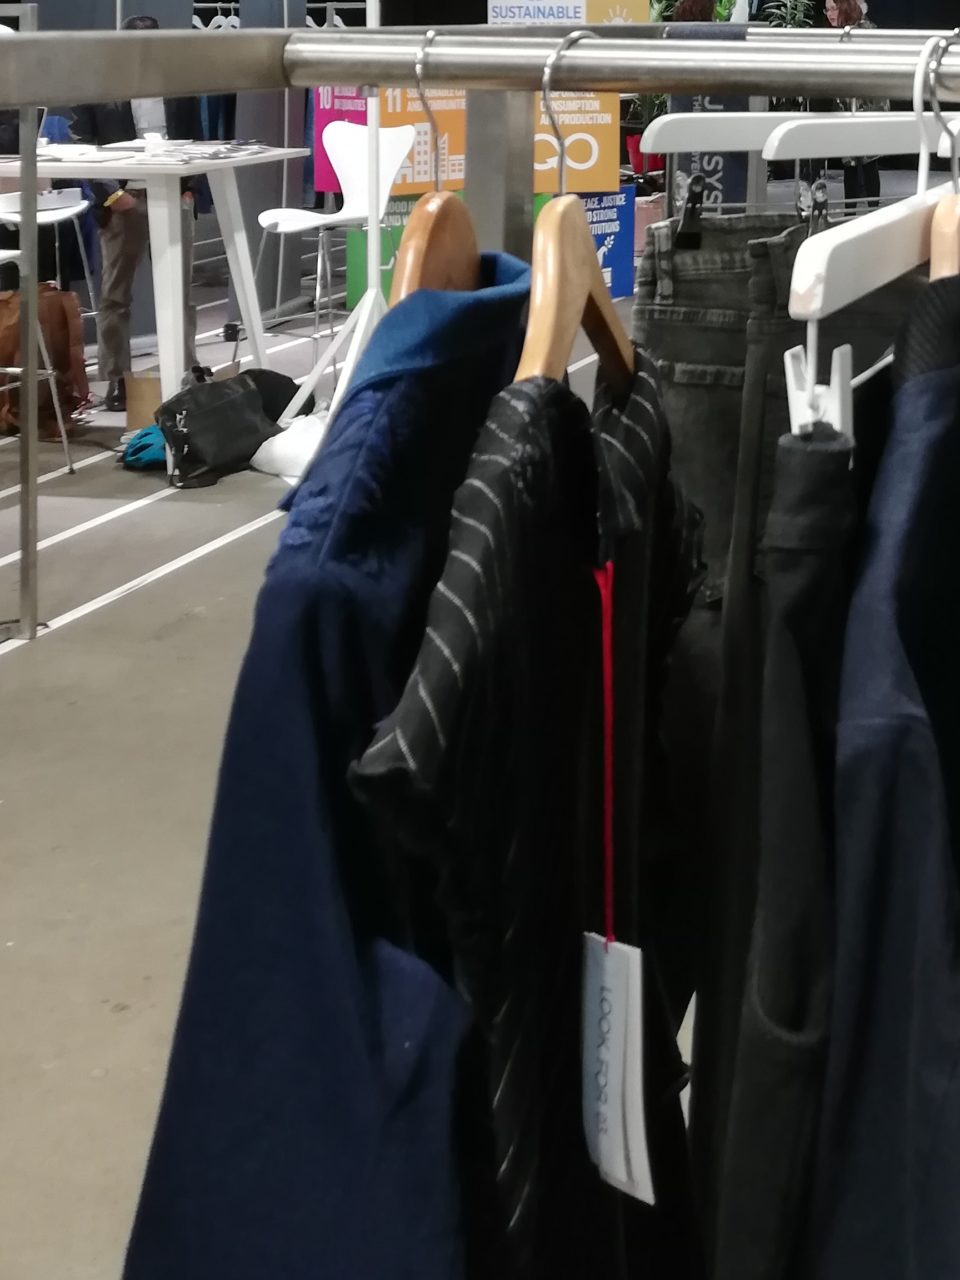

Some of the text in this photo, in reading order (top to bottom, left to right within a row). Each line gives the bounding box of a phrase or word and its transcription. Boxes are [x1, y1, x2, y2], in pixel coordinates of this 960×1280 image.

[492, 6, 582, 19] SUSTAINABLE
[319, 86, 331, 109] 10
[385, 88, 400, 112] 11
[541, 100, 600, 111] CNSUMPTION
